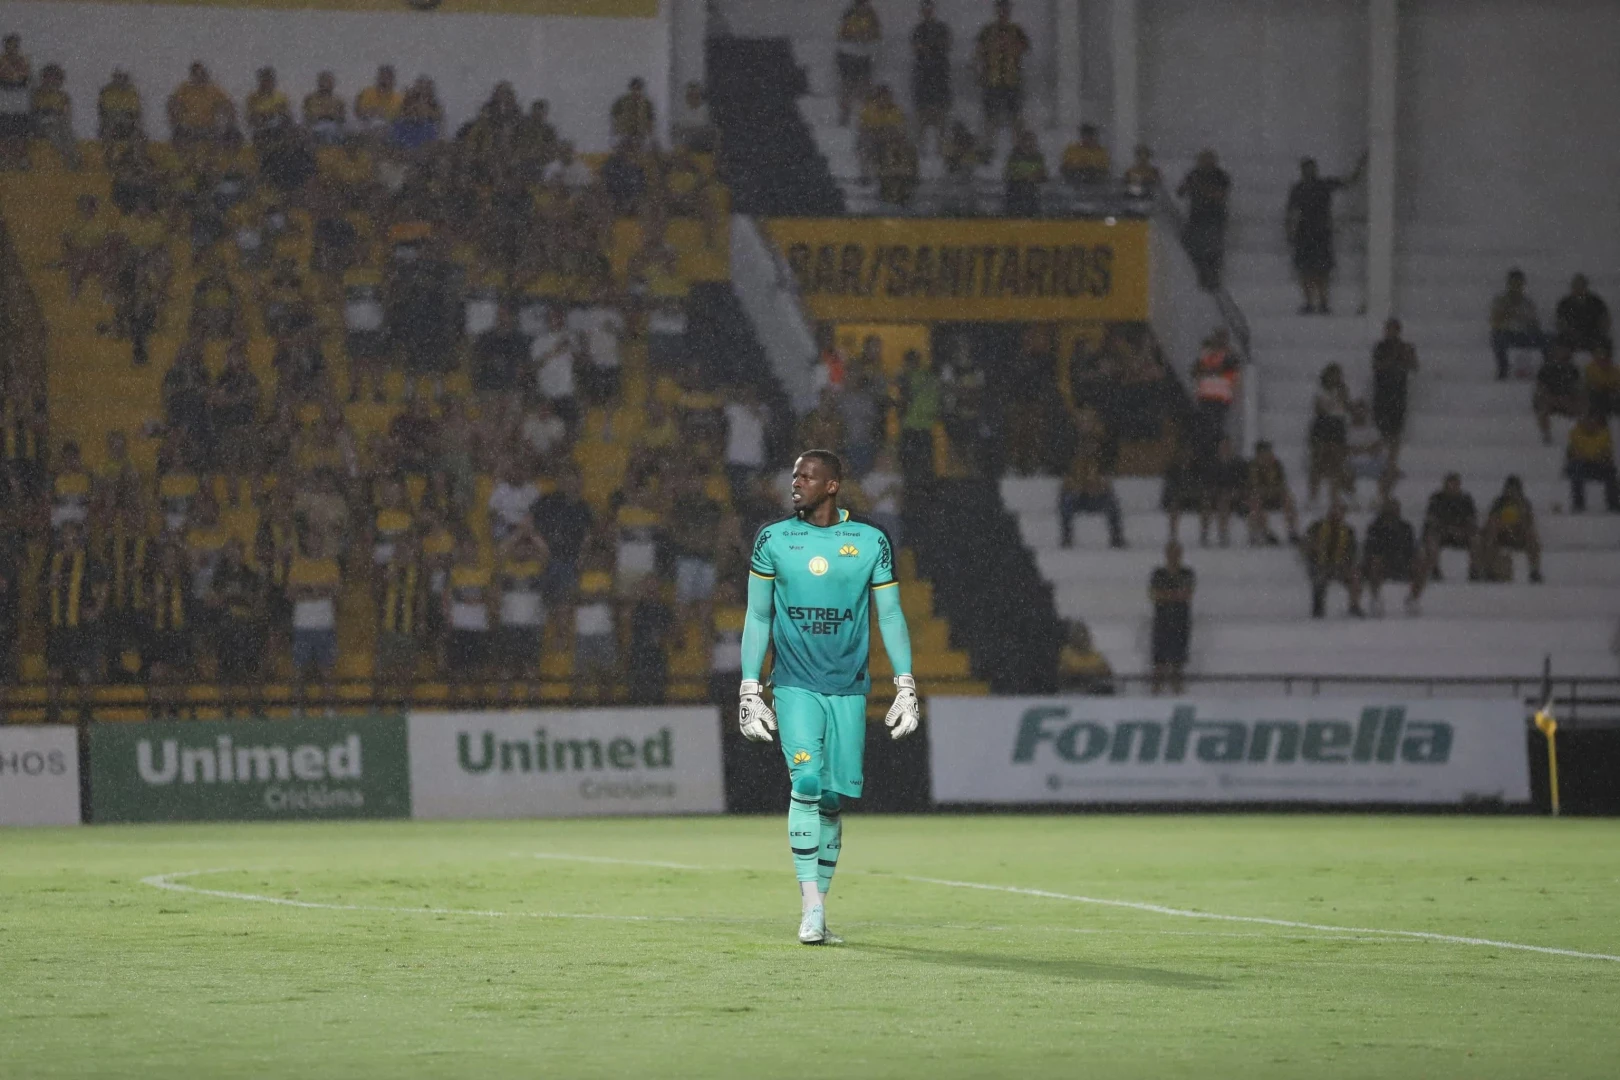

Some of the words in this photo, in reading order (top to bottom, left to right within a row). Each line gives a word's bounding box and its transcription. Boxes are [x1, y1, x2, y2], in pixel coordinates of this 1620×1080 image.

[788, 606, 853, 621] ESTRELA
[812, 621, 841, 635] BET
[456, 727, 674, 774] Unimed
[1011, 704, 1455, 764] Fontanella
[136, 733, 362, 785] Unimed
